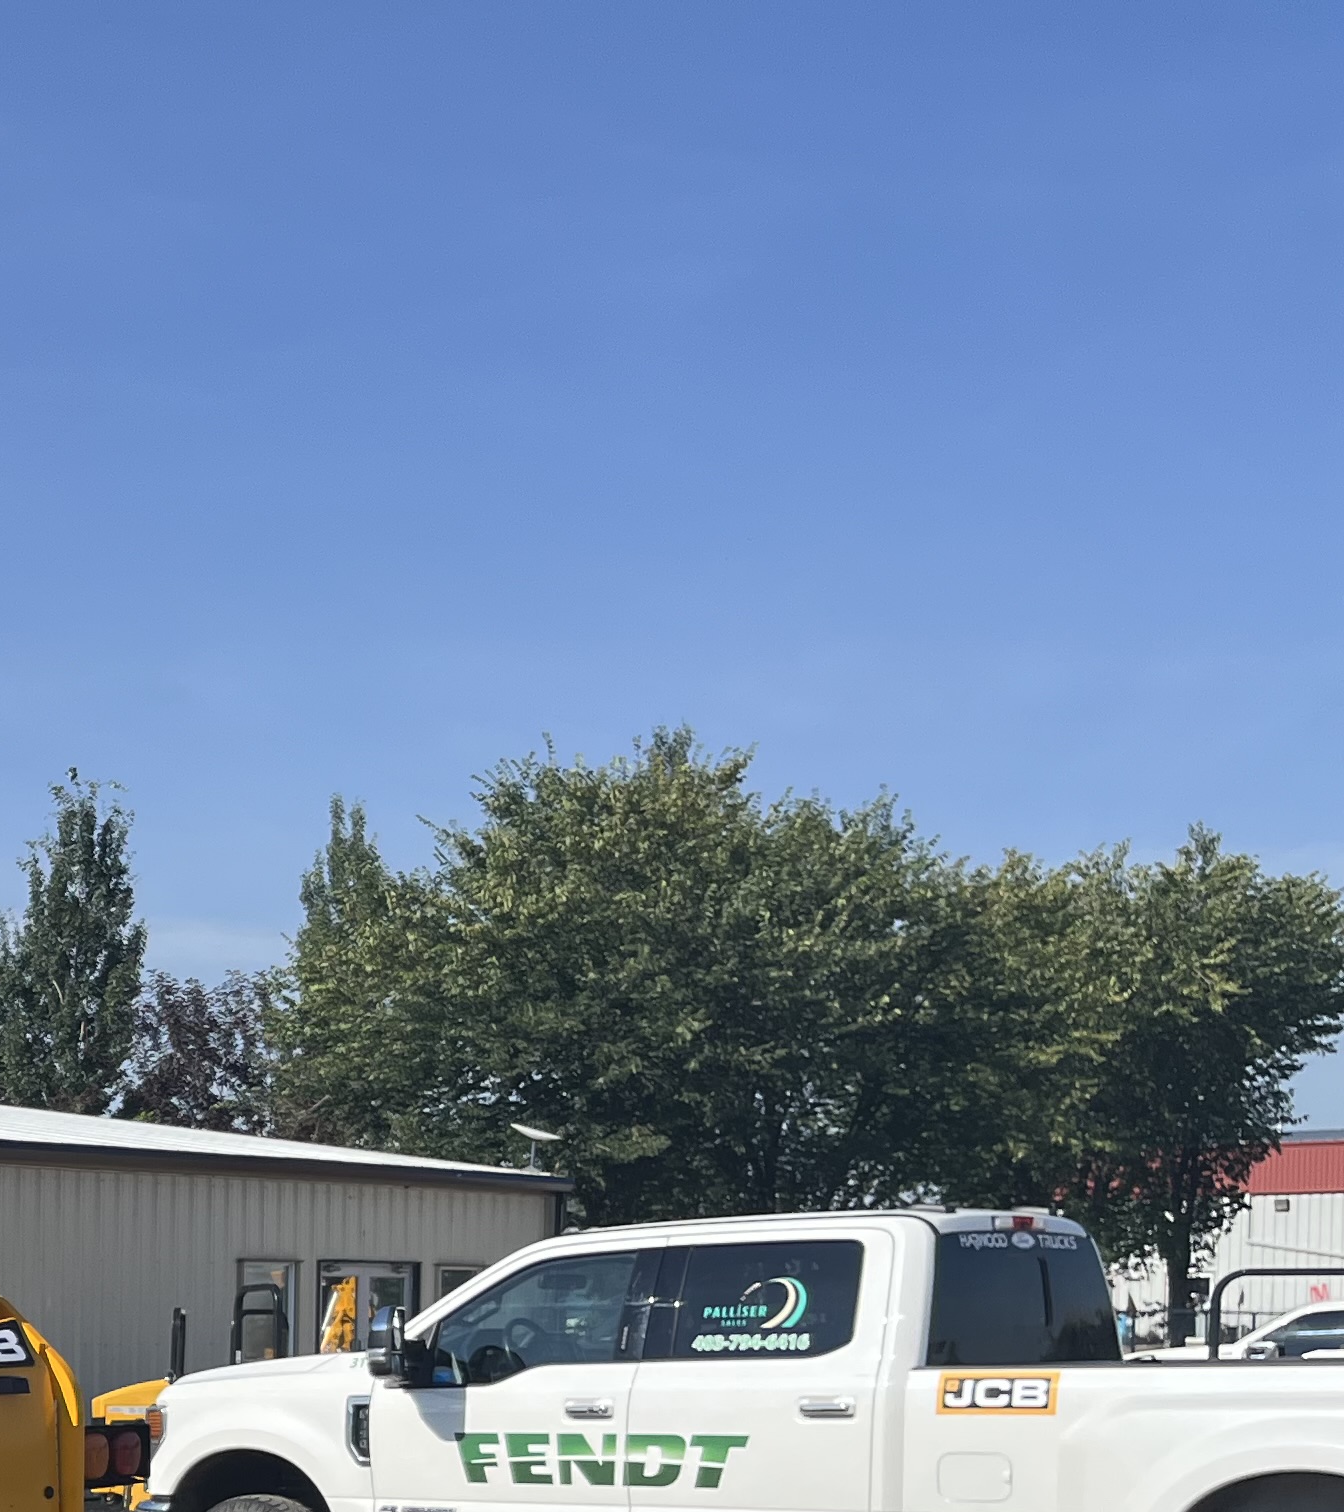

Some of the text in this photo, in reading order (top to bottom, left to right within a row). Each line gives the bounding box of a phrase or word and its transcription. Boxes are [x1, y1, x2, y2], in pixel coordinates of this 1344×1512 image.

[1037, 1234, 1077, 1250] TRUCKS
[703, 1304, 768, 1319] PALLISER
[944, 1378, 1049, 1408] JCB
[455, 1432, 749, 1488] FENDT
